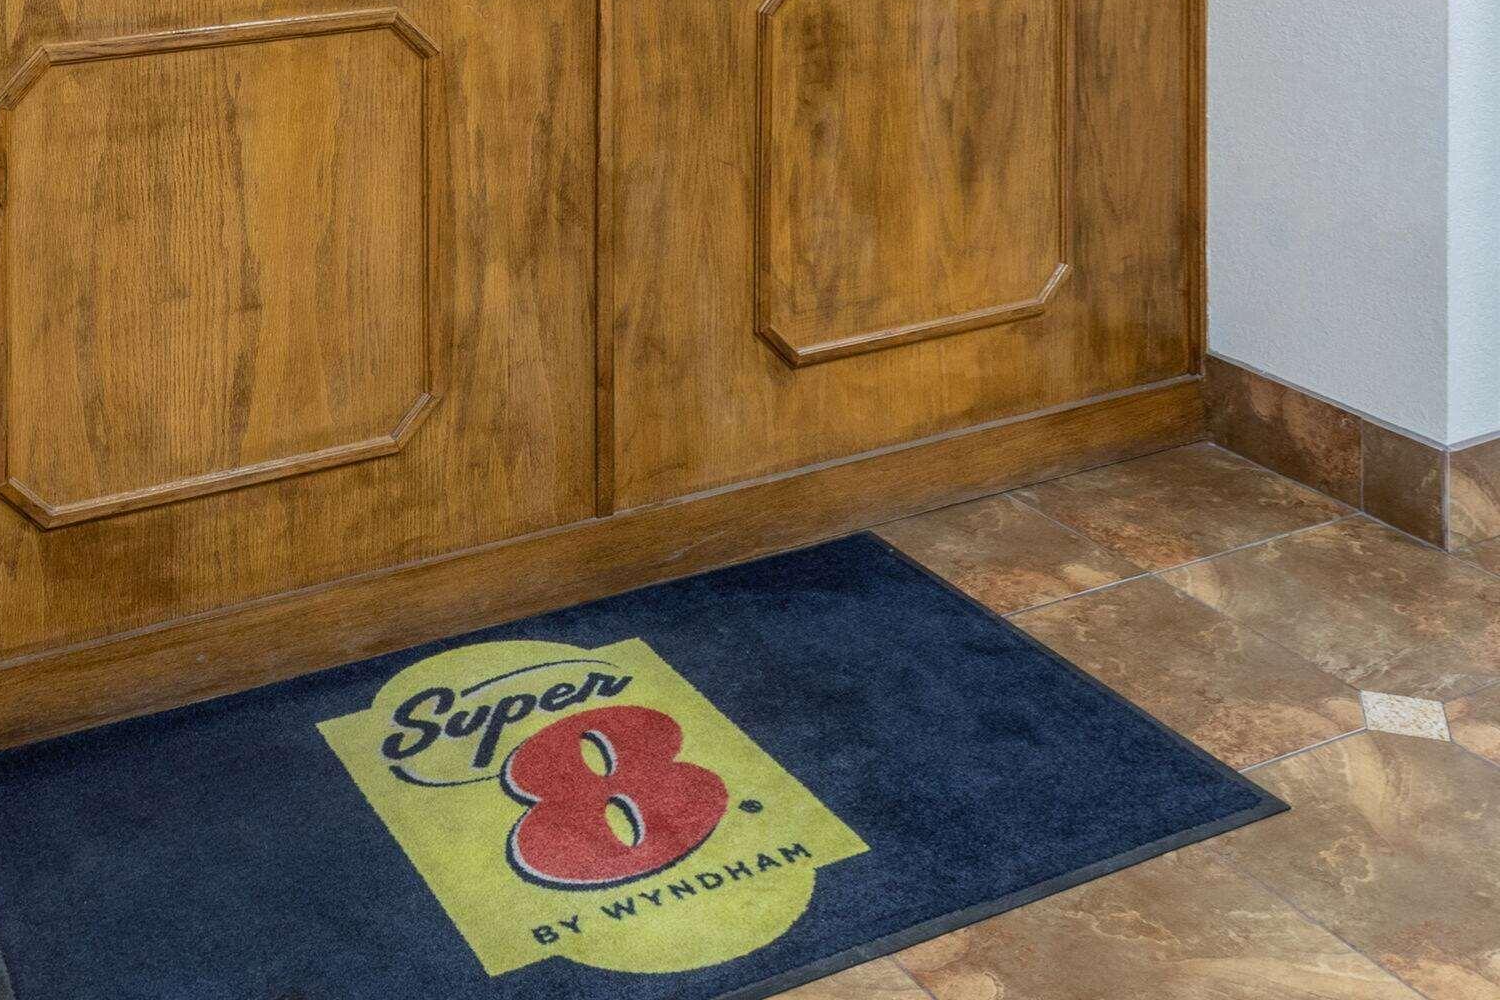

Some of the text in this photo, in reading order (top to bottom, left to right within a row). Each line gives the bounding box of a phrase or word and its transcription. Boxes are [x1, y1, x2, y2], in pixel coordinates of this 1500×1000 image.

[381, 672, 633, 769] Super
[500, 704, 730, 892] 8
[531, 842, 813, 946] BY WYNDHAM
